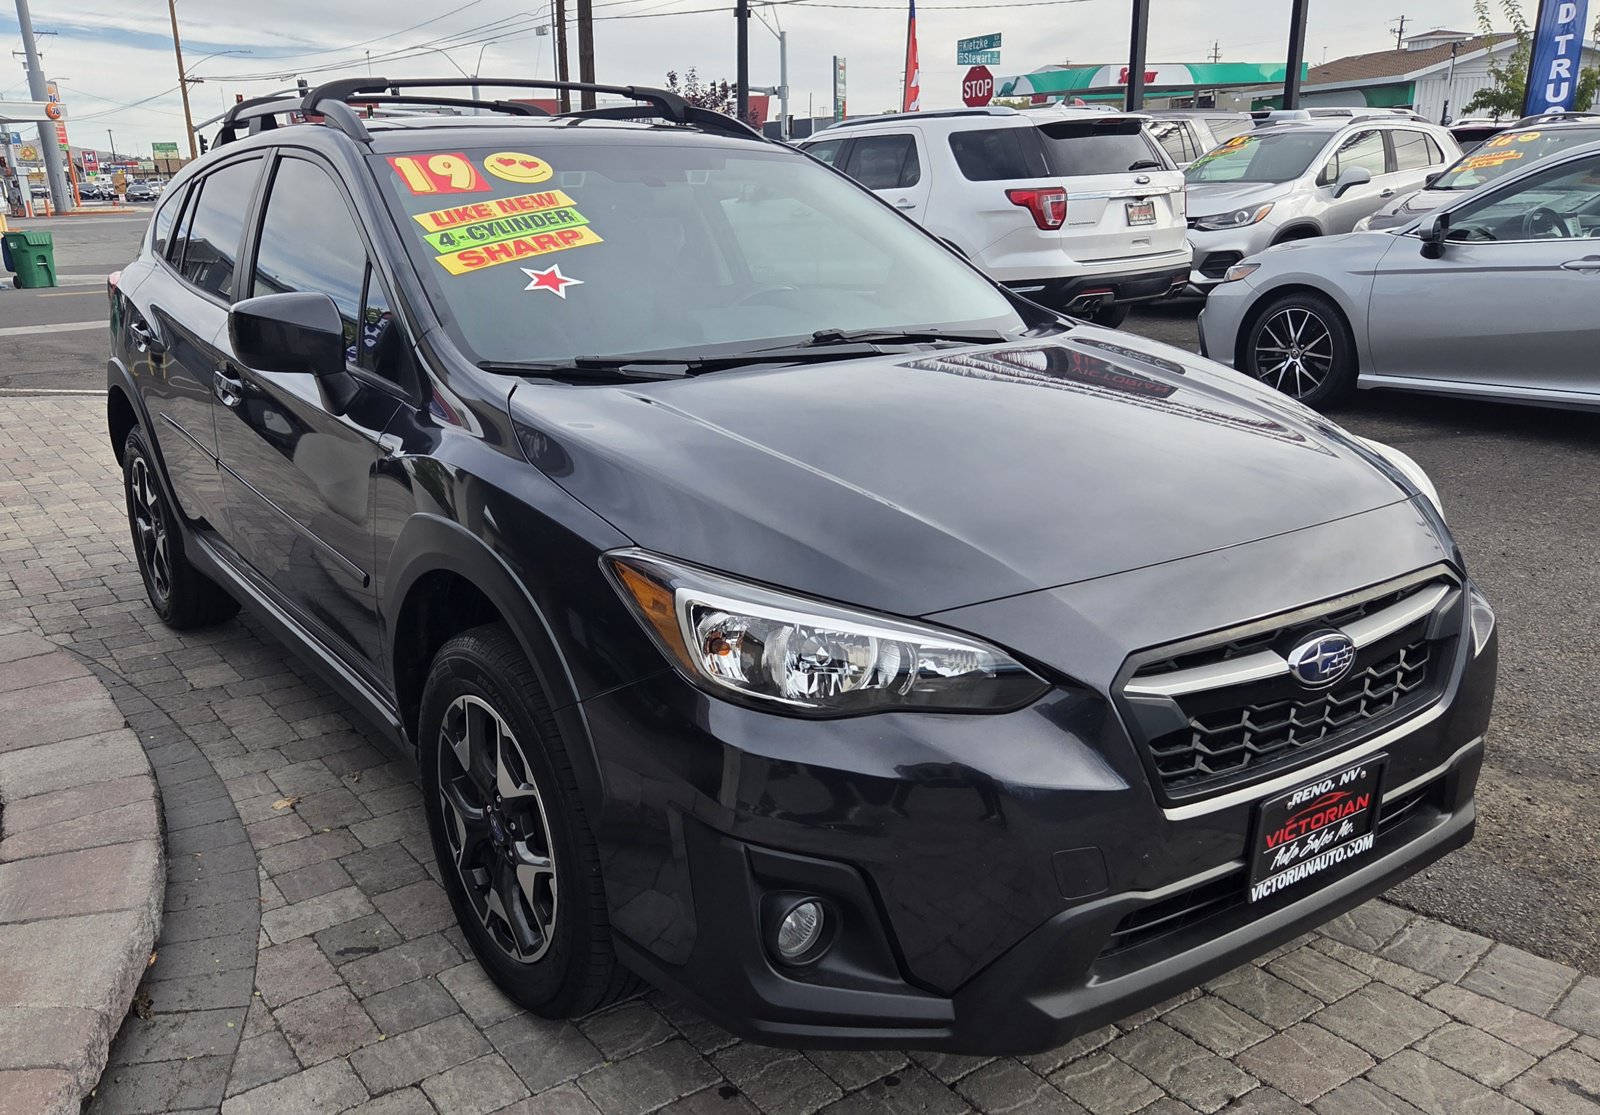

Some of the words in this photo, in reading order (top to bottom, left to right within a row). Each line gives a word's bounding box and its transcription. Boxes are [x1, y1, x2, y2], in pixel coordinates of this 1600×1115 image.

[962, 38, 988, 51] Kietzke
[963, 53, 991, 64] Stewart
[963, 79, 992, 99] STOP
[394, 154, 477, 192] 19
[429, 202, 498, 229] LIKE
[495, 191, 561, 216] NEW
[437, 208, 578, 248] 4-CYLINDER
[456, 229, 584, 269] SHARP
[1291, 779, 1336, 806] RENO,
[1339, 767, 1361, 787] NV
[1265, 793, 1371, 849] VICTORIAN
[1270, 840, 1300, 870] Auto
[1299, 828, 1335, 858] Sales
[1334, 819, 1354, 842] Inc.
[1250, 833, 1375, 903] VICTORIANAUTO.COM
